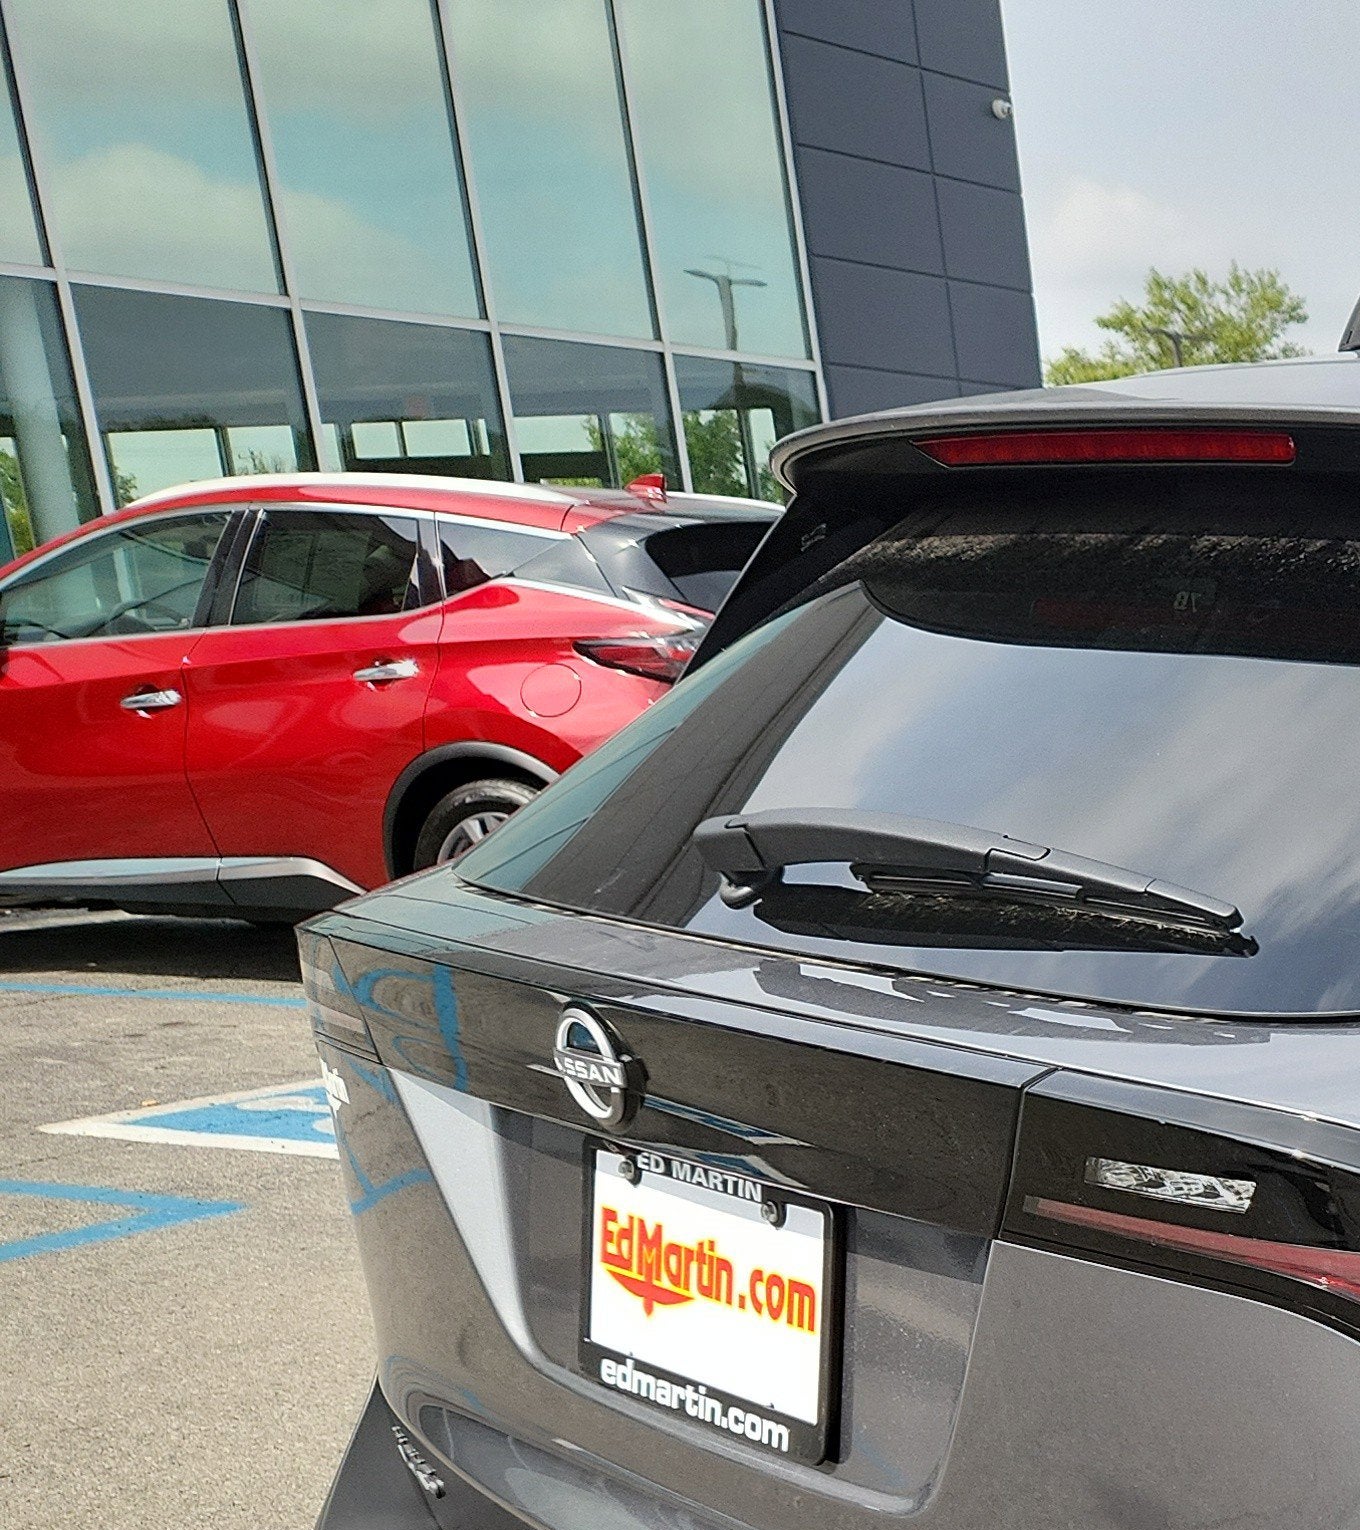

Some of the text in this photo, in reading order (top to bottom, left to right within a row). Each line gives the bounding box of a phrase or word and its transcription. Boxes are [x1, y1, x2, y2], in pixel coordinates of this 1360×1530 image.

[637, 1152, 763, 1203] ED MARTIN
[600, 1205, 816, 1333] EdMartin.com
[600, 1357, 790, 1453] edmartin.com
